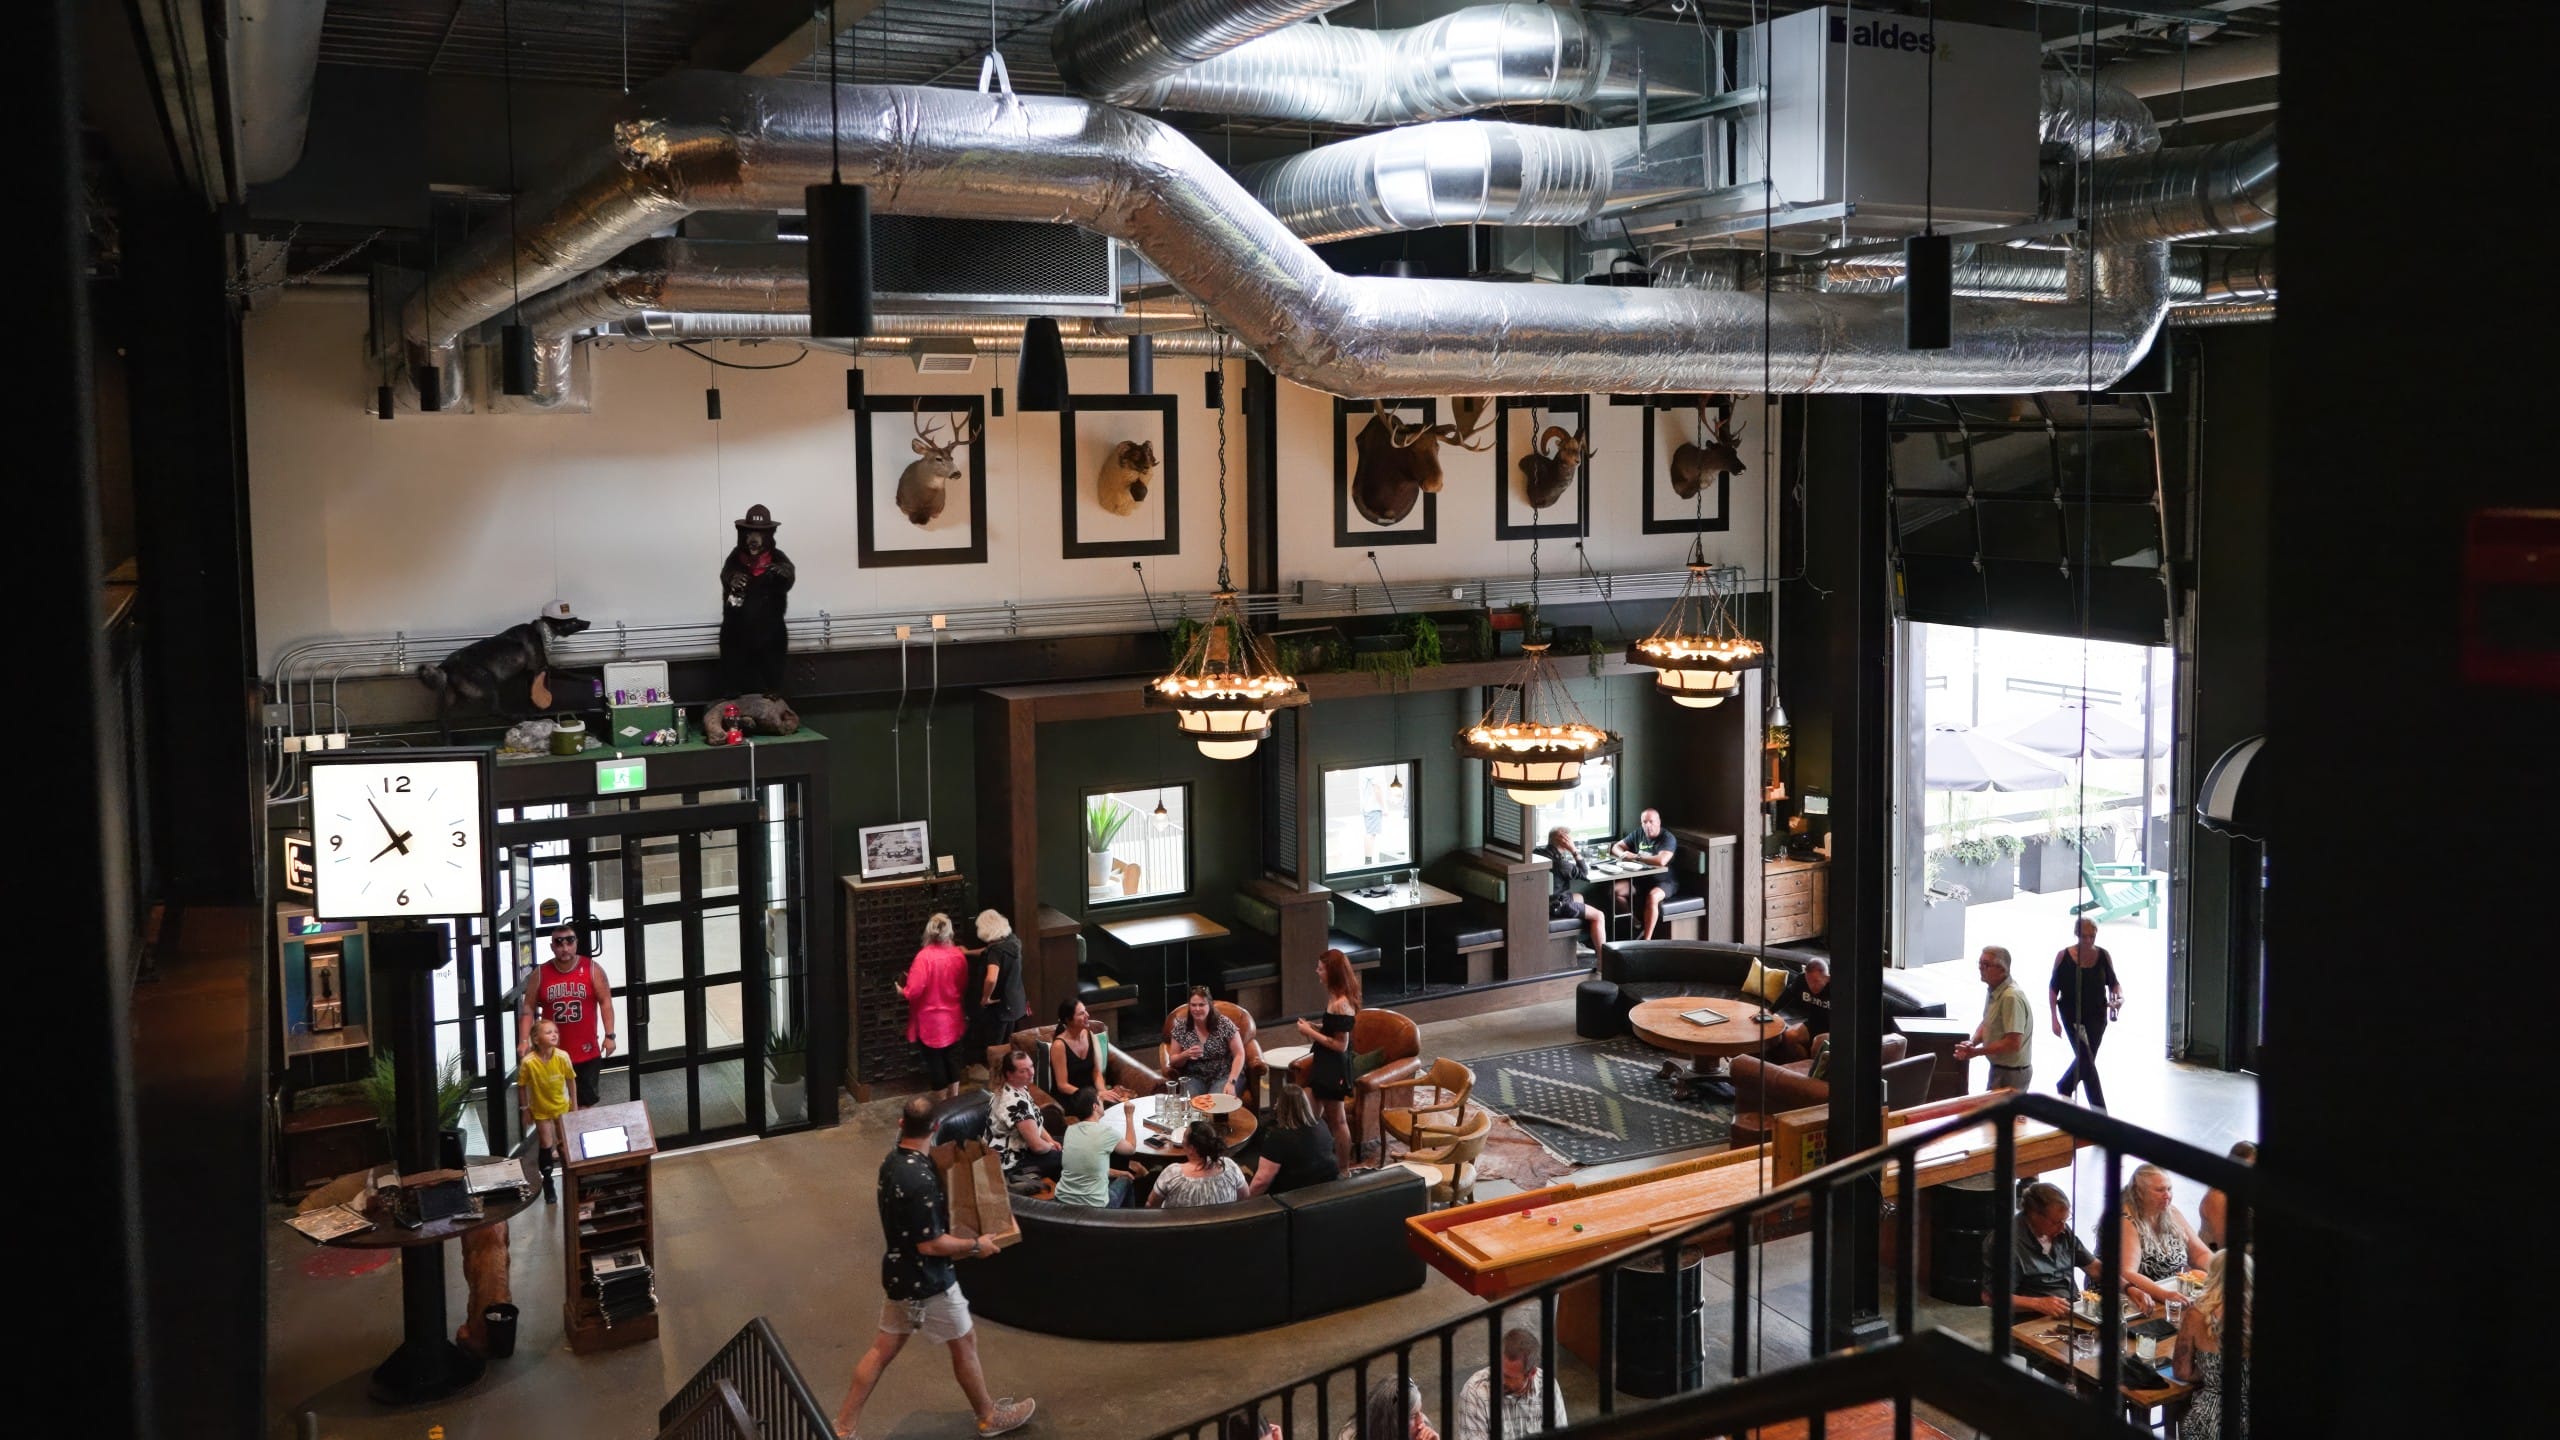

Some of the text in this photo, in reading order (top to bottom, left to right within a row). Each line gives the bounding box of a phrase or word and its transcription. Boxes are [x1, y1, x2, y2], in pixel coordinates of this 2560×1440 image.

[1852, 20, 1936, 54] aldes
[383, 775, 412, 794] 12
[329, 834, 343, 852] 9
[451, 830, 467, 848] 3
[396, 888, 410, 906] 6
[547, 981, 586, 1001] BULLS
[553, 1000, 583, 1024] 23
